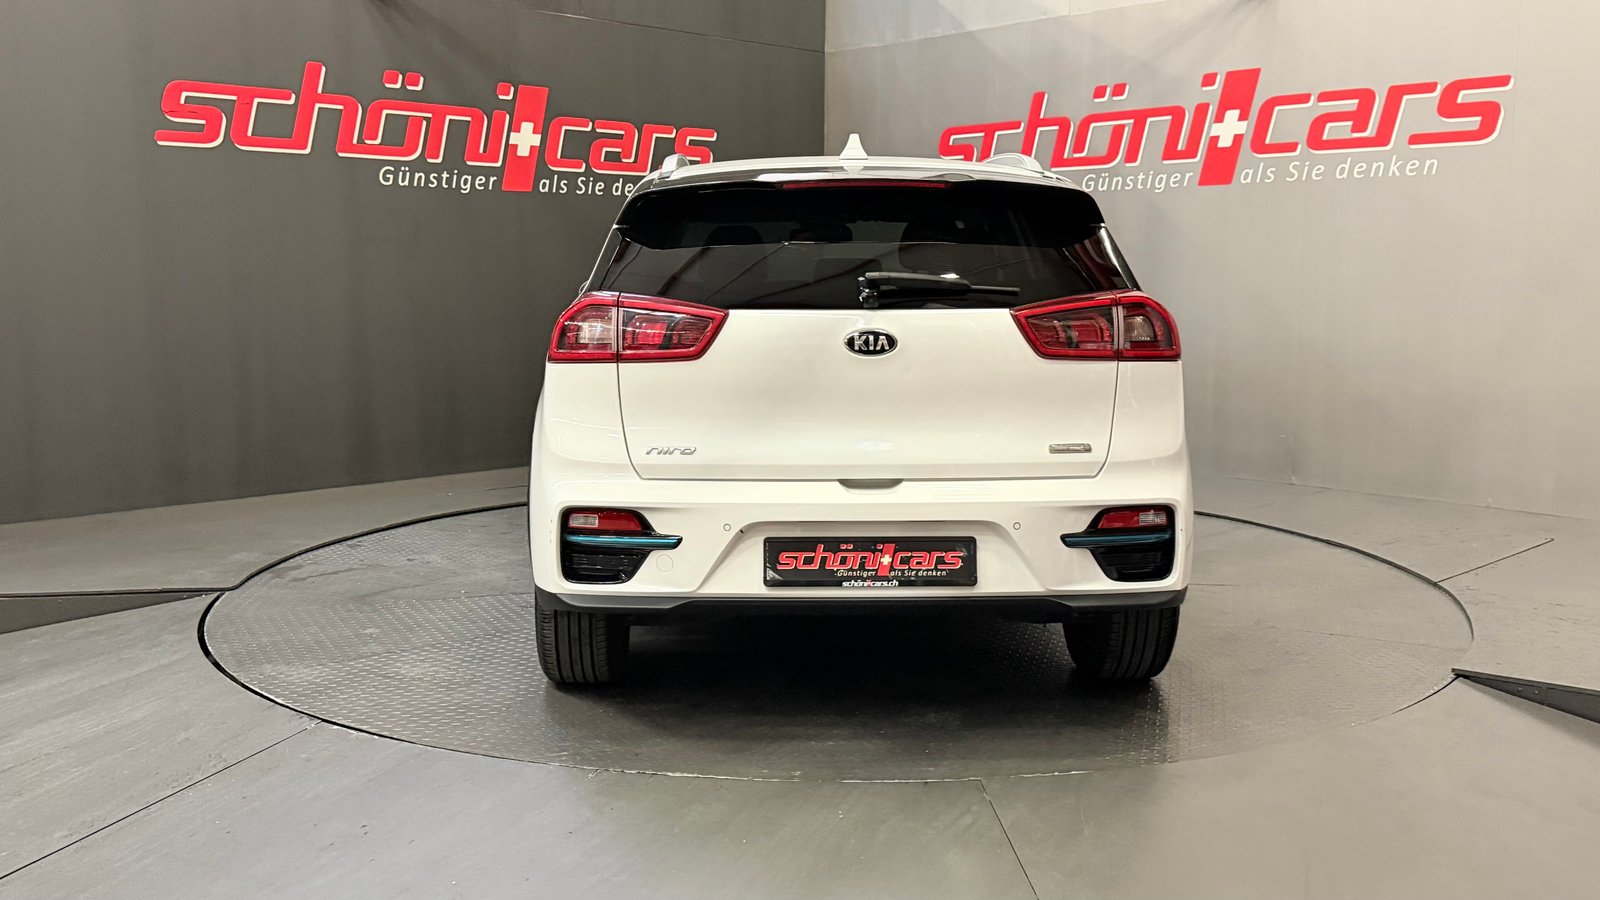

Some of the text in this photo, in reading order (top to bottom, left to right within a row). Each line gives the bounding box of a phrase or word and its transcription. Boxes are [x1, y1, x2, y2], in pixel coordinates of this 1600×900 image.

[378, 165, 634, 196] Günstiger als Sie de
[1082, 154, 1439, 193] Günstiger als Sie denken
[853, 335, 890, 351] KIA
[837, 569, 948, 578] Günstiger als Sie denken
